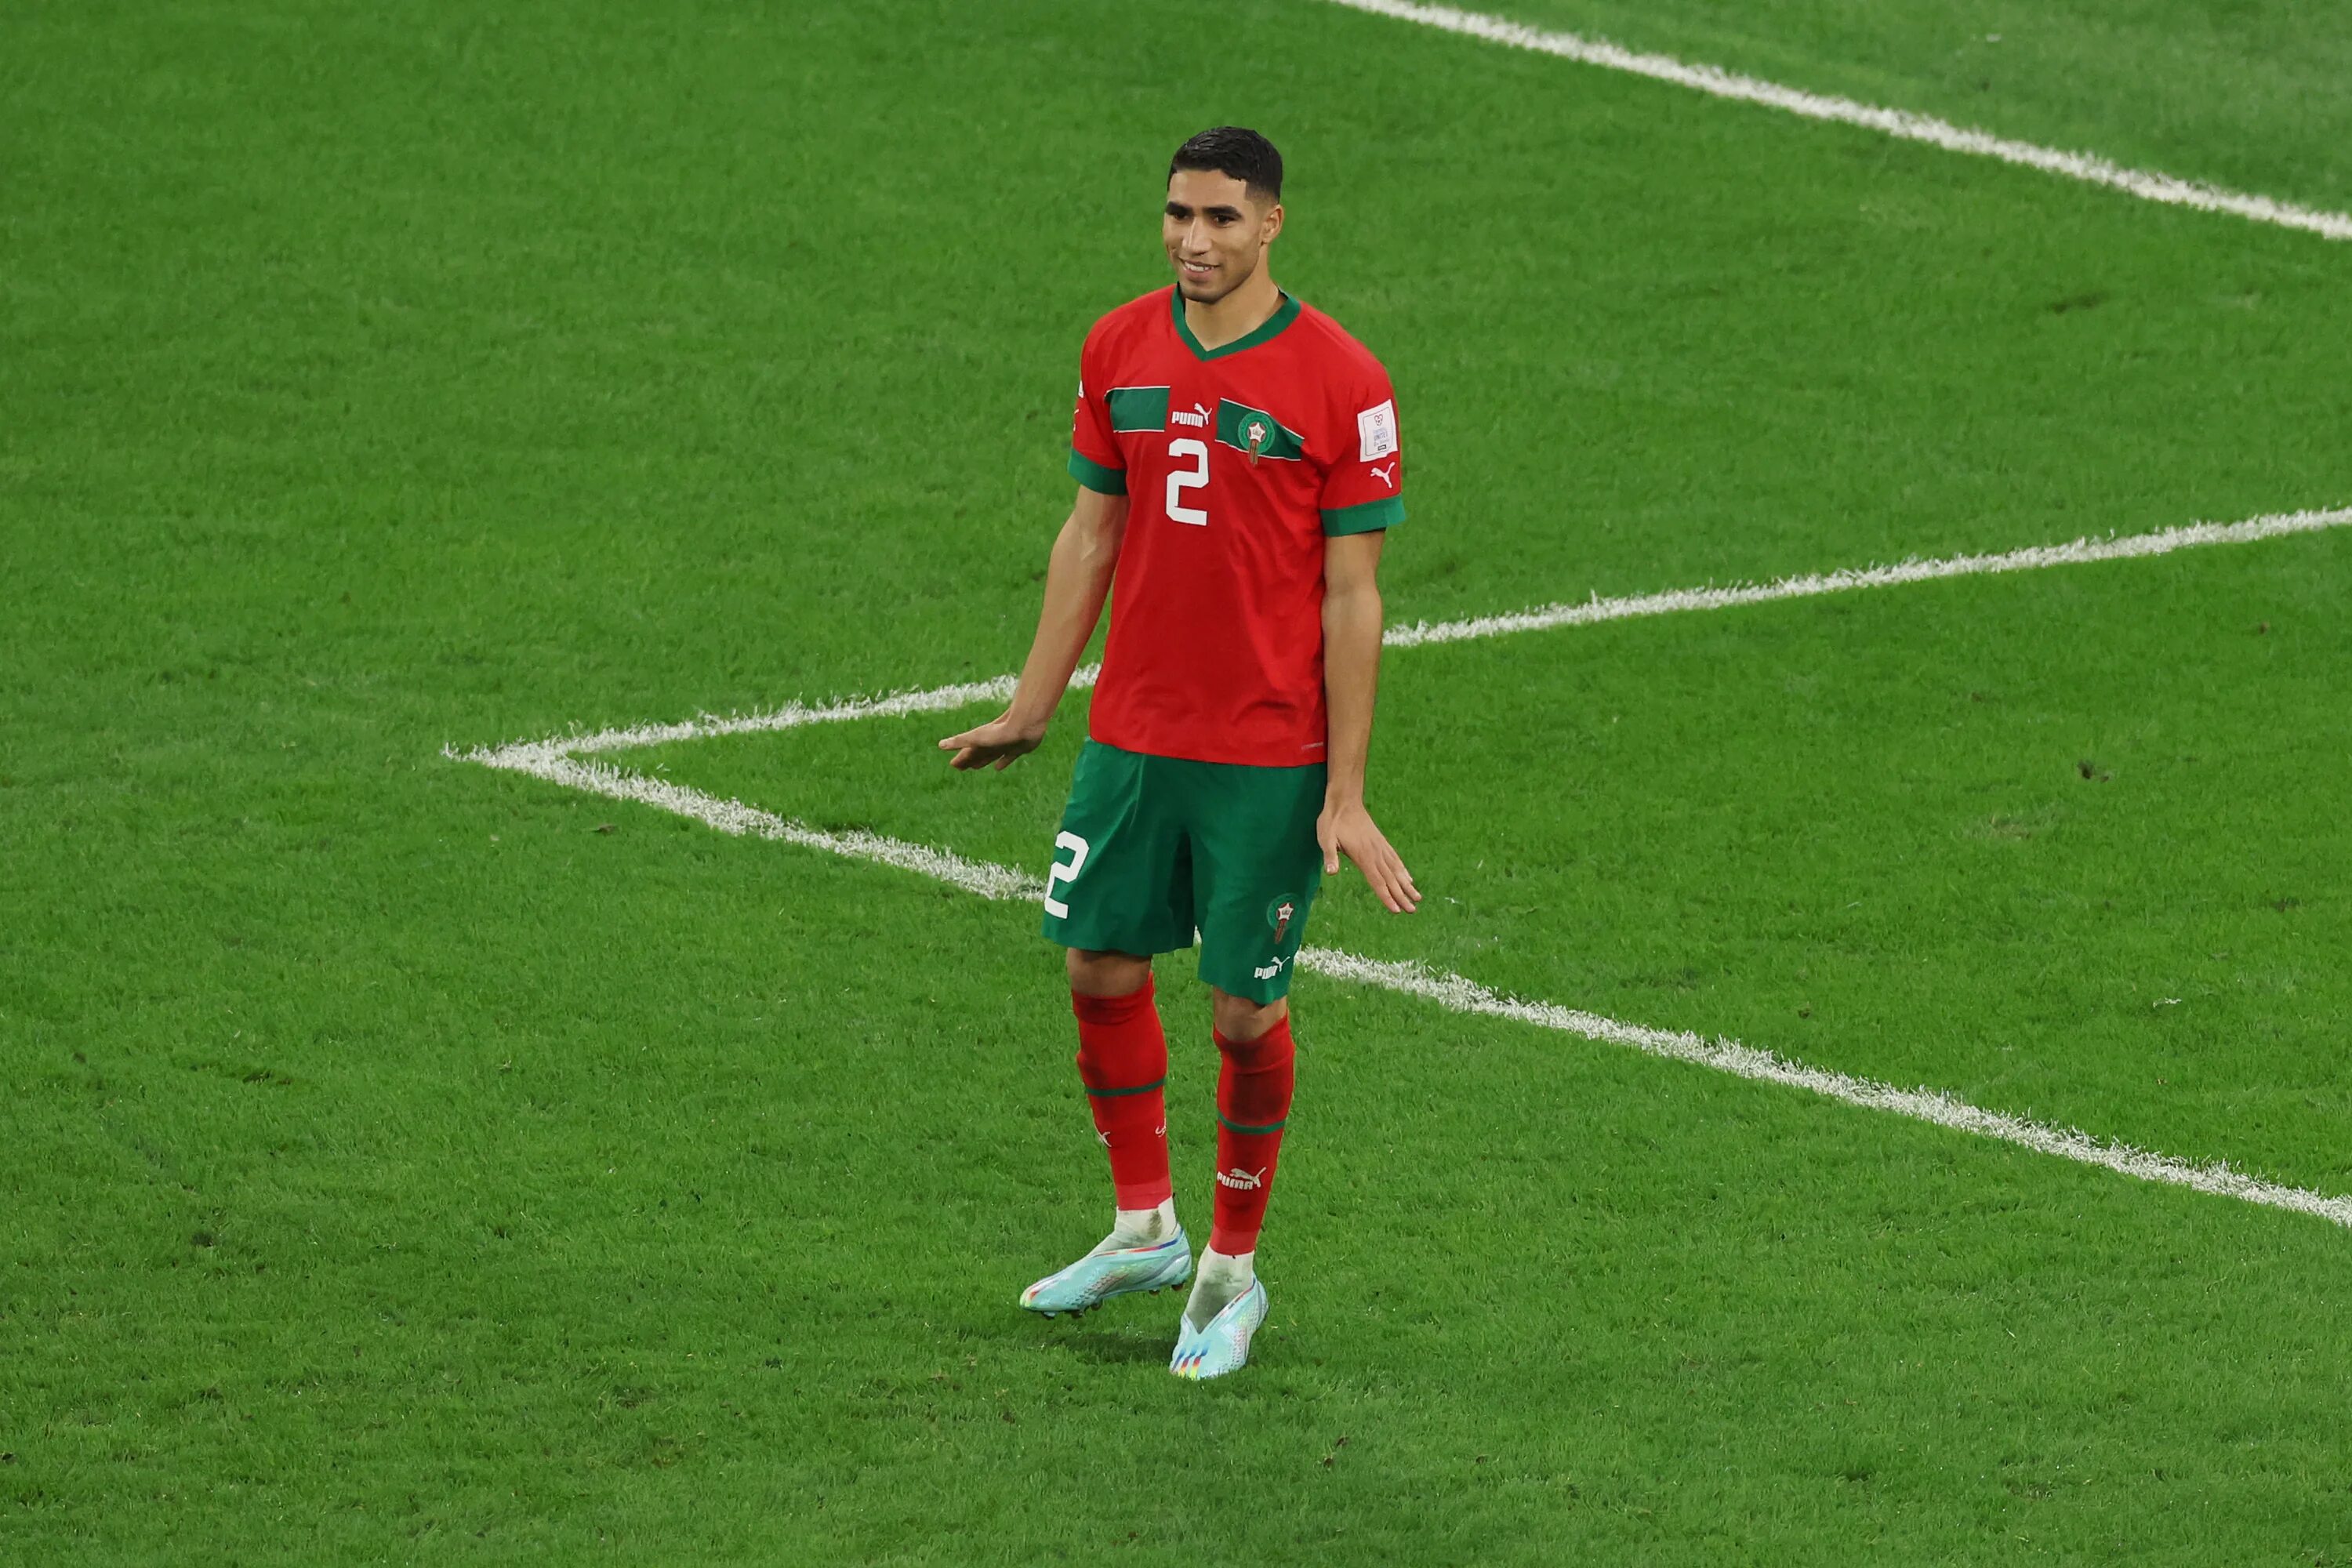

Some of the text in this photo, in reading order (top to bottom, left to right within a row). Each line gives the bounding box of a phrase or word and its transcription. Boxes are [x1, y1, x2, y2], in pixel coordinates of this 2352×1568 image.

[1171, 411, 1203, 428] PUMA
[1166, 437, 1209, 526] 2
[1044, 830, 1090, 920] 2
[1217, 1171, 1254, 1190] PUMA
